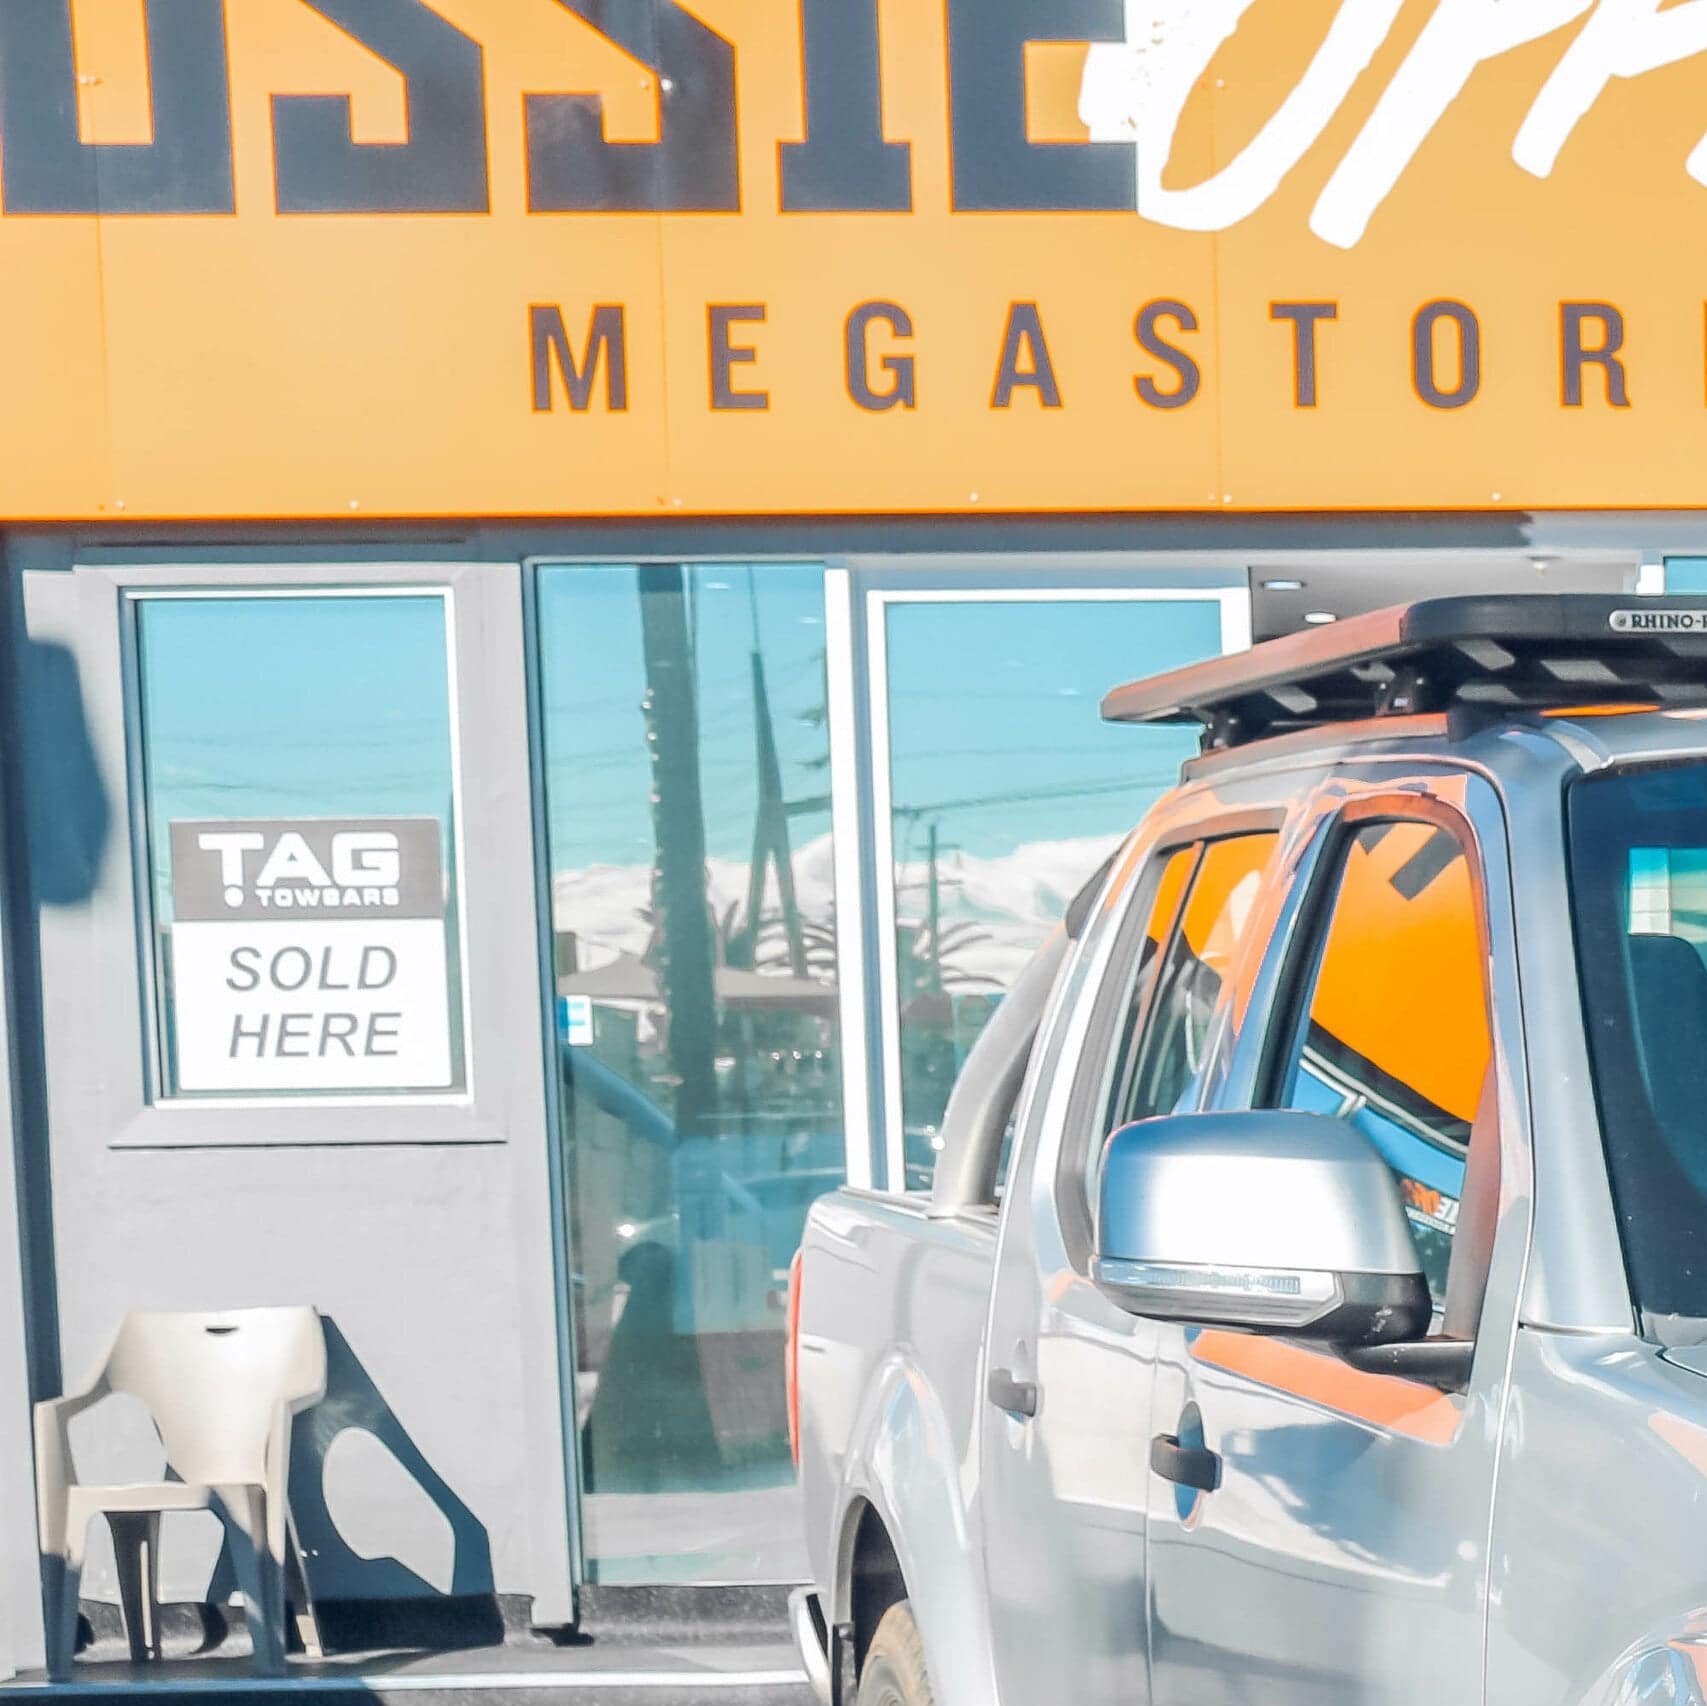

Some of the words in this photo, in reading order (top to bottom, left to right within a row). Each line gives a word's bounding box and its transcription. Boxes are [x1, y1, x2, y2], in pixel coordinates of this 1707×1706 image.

[198, 832, 400, 888] TAG
[256, 887, 400, 908] TOWBARS
[225, 945, 398, 992] SOLD
[228, 1011, 402, 1058] HERE
